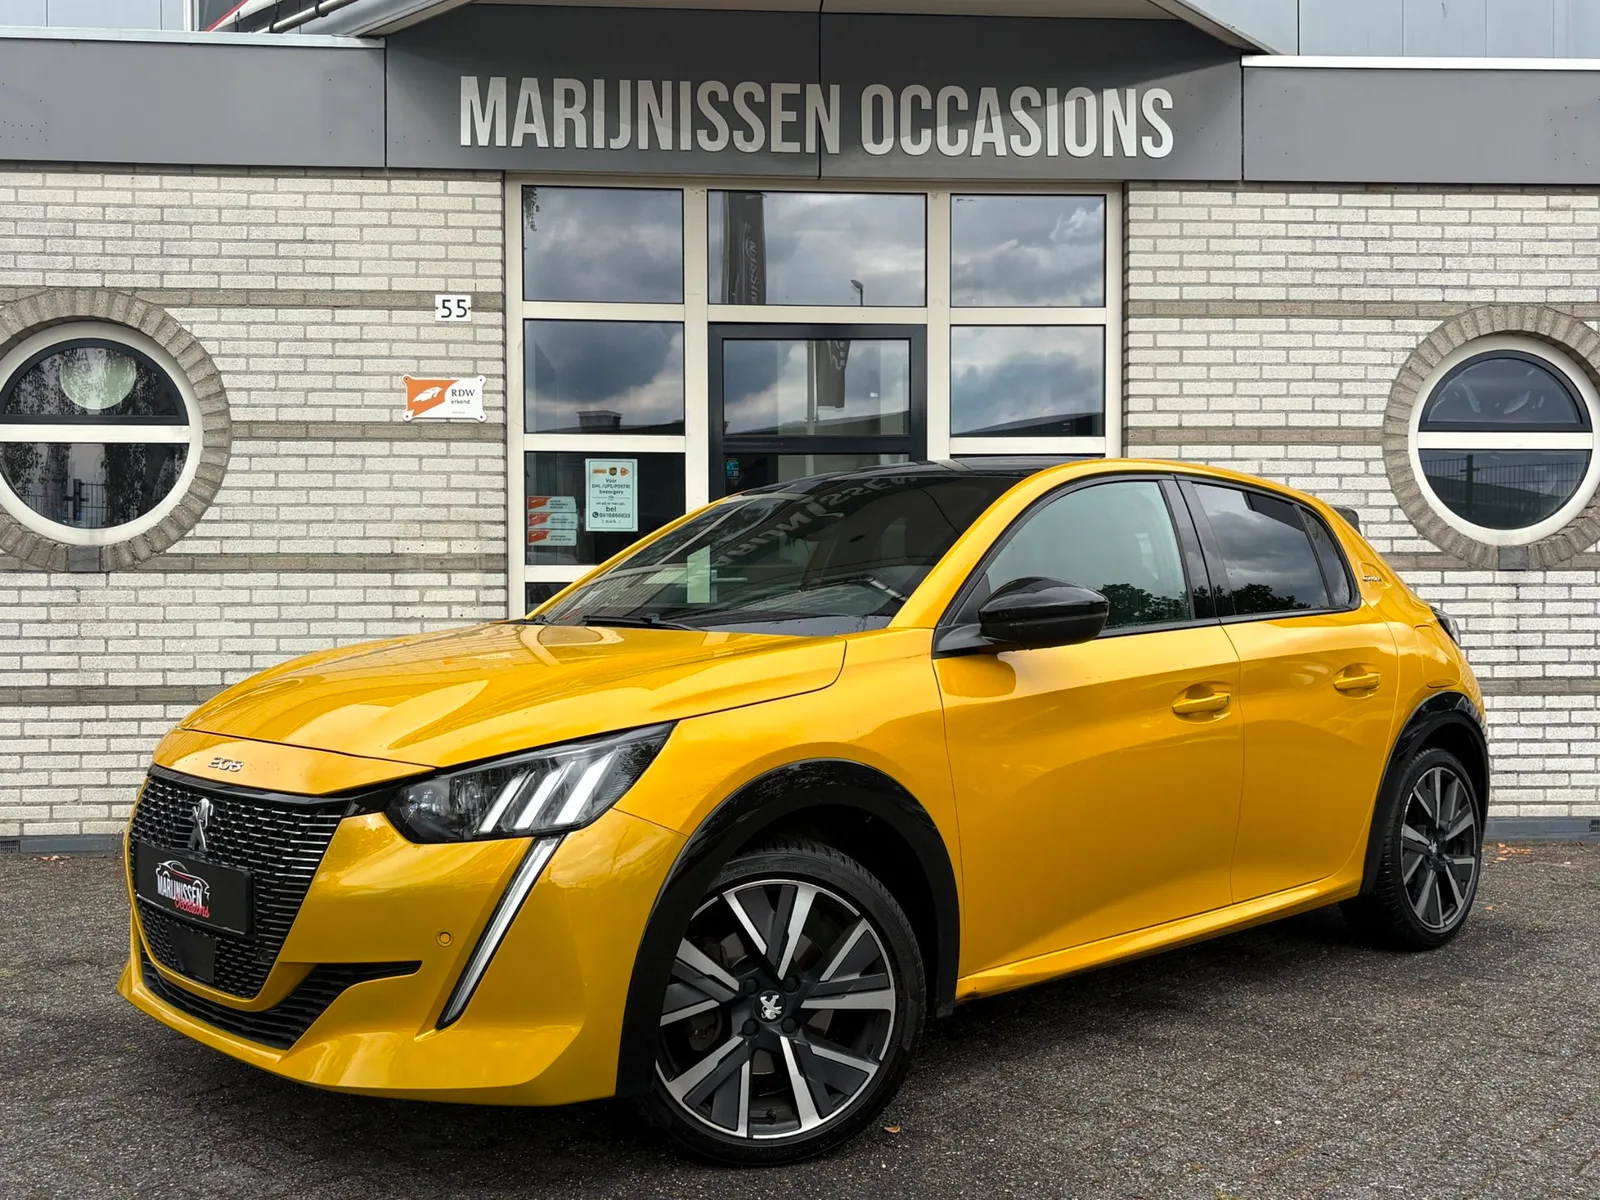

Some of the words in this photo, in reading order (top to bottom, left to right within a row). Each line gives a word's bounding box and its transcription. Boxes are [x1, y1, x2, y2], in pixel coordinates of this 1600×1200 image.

[460, 75, 840, 154] MARIJNISSEN
[861, 84, 1173, 158] OCCASIONS
[441, 299, 467, 318] 55
[451, 388, 476, 397] RDW
[208, 757, 244, 772] 208
[157, 871, 203, 908] MARIJNISSEN
